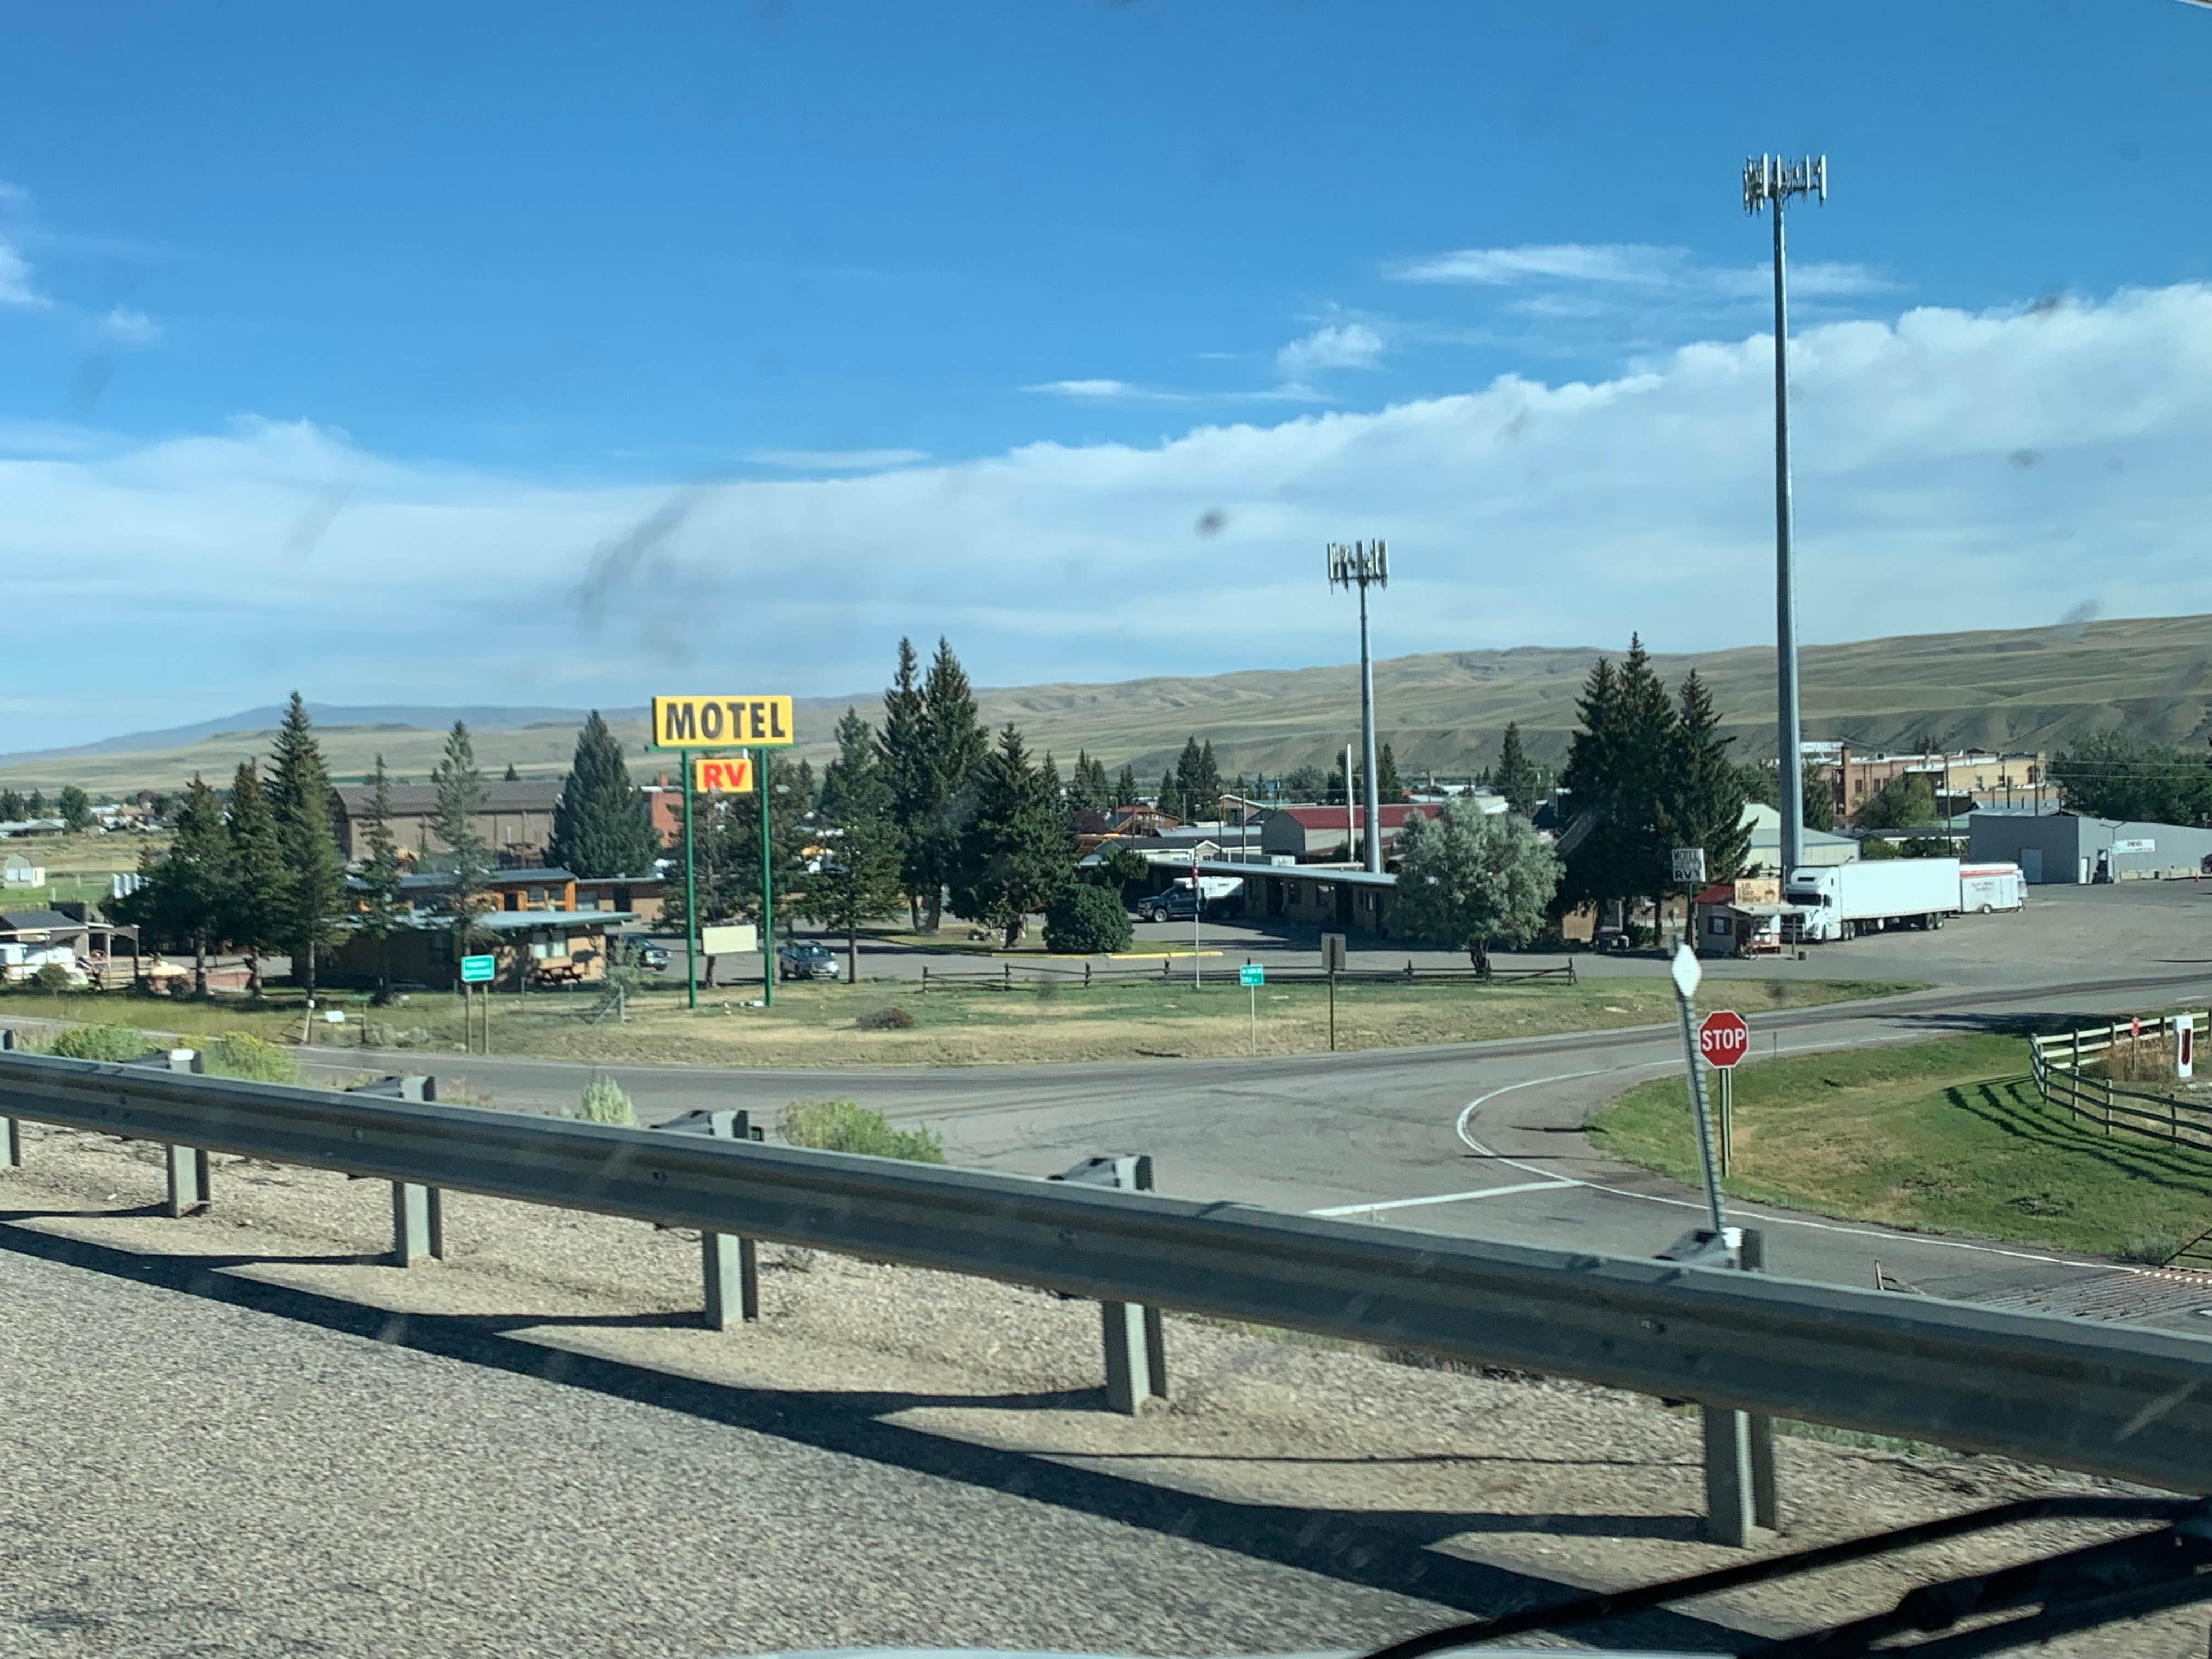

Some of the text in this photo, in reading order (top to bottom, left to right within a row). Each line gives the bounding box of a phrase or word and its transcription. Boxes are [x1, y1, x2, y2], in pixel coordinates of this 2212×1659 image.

[665, 702, 786, 740] MOTEL
[703, 763, 746, 788] RV
[1673, 851, 1700, 860] MOTEL
[1702, 1028, 1745, 1051] STOP
